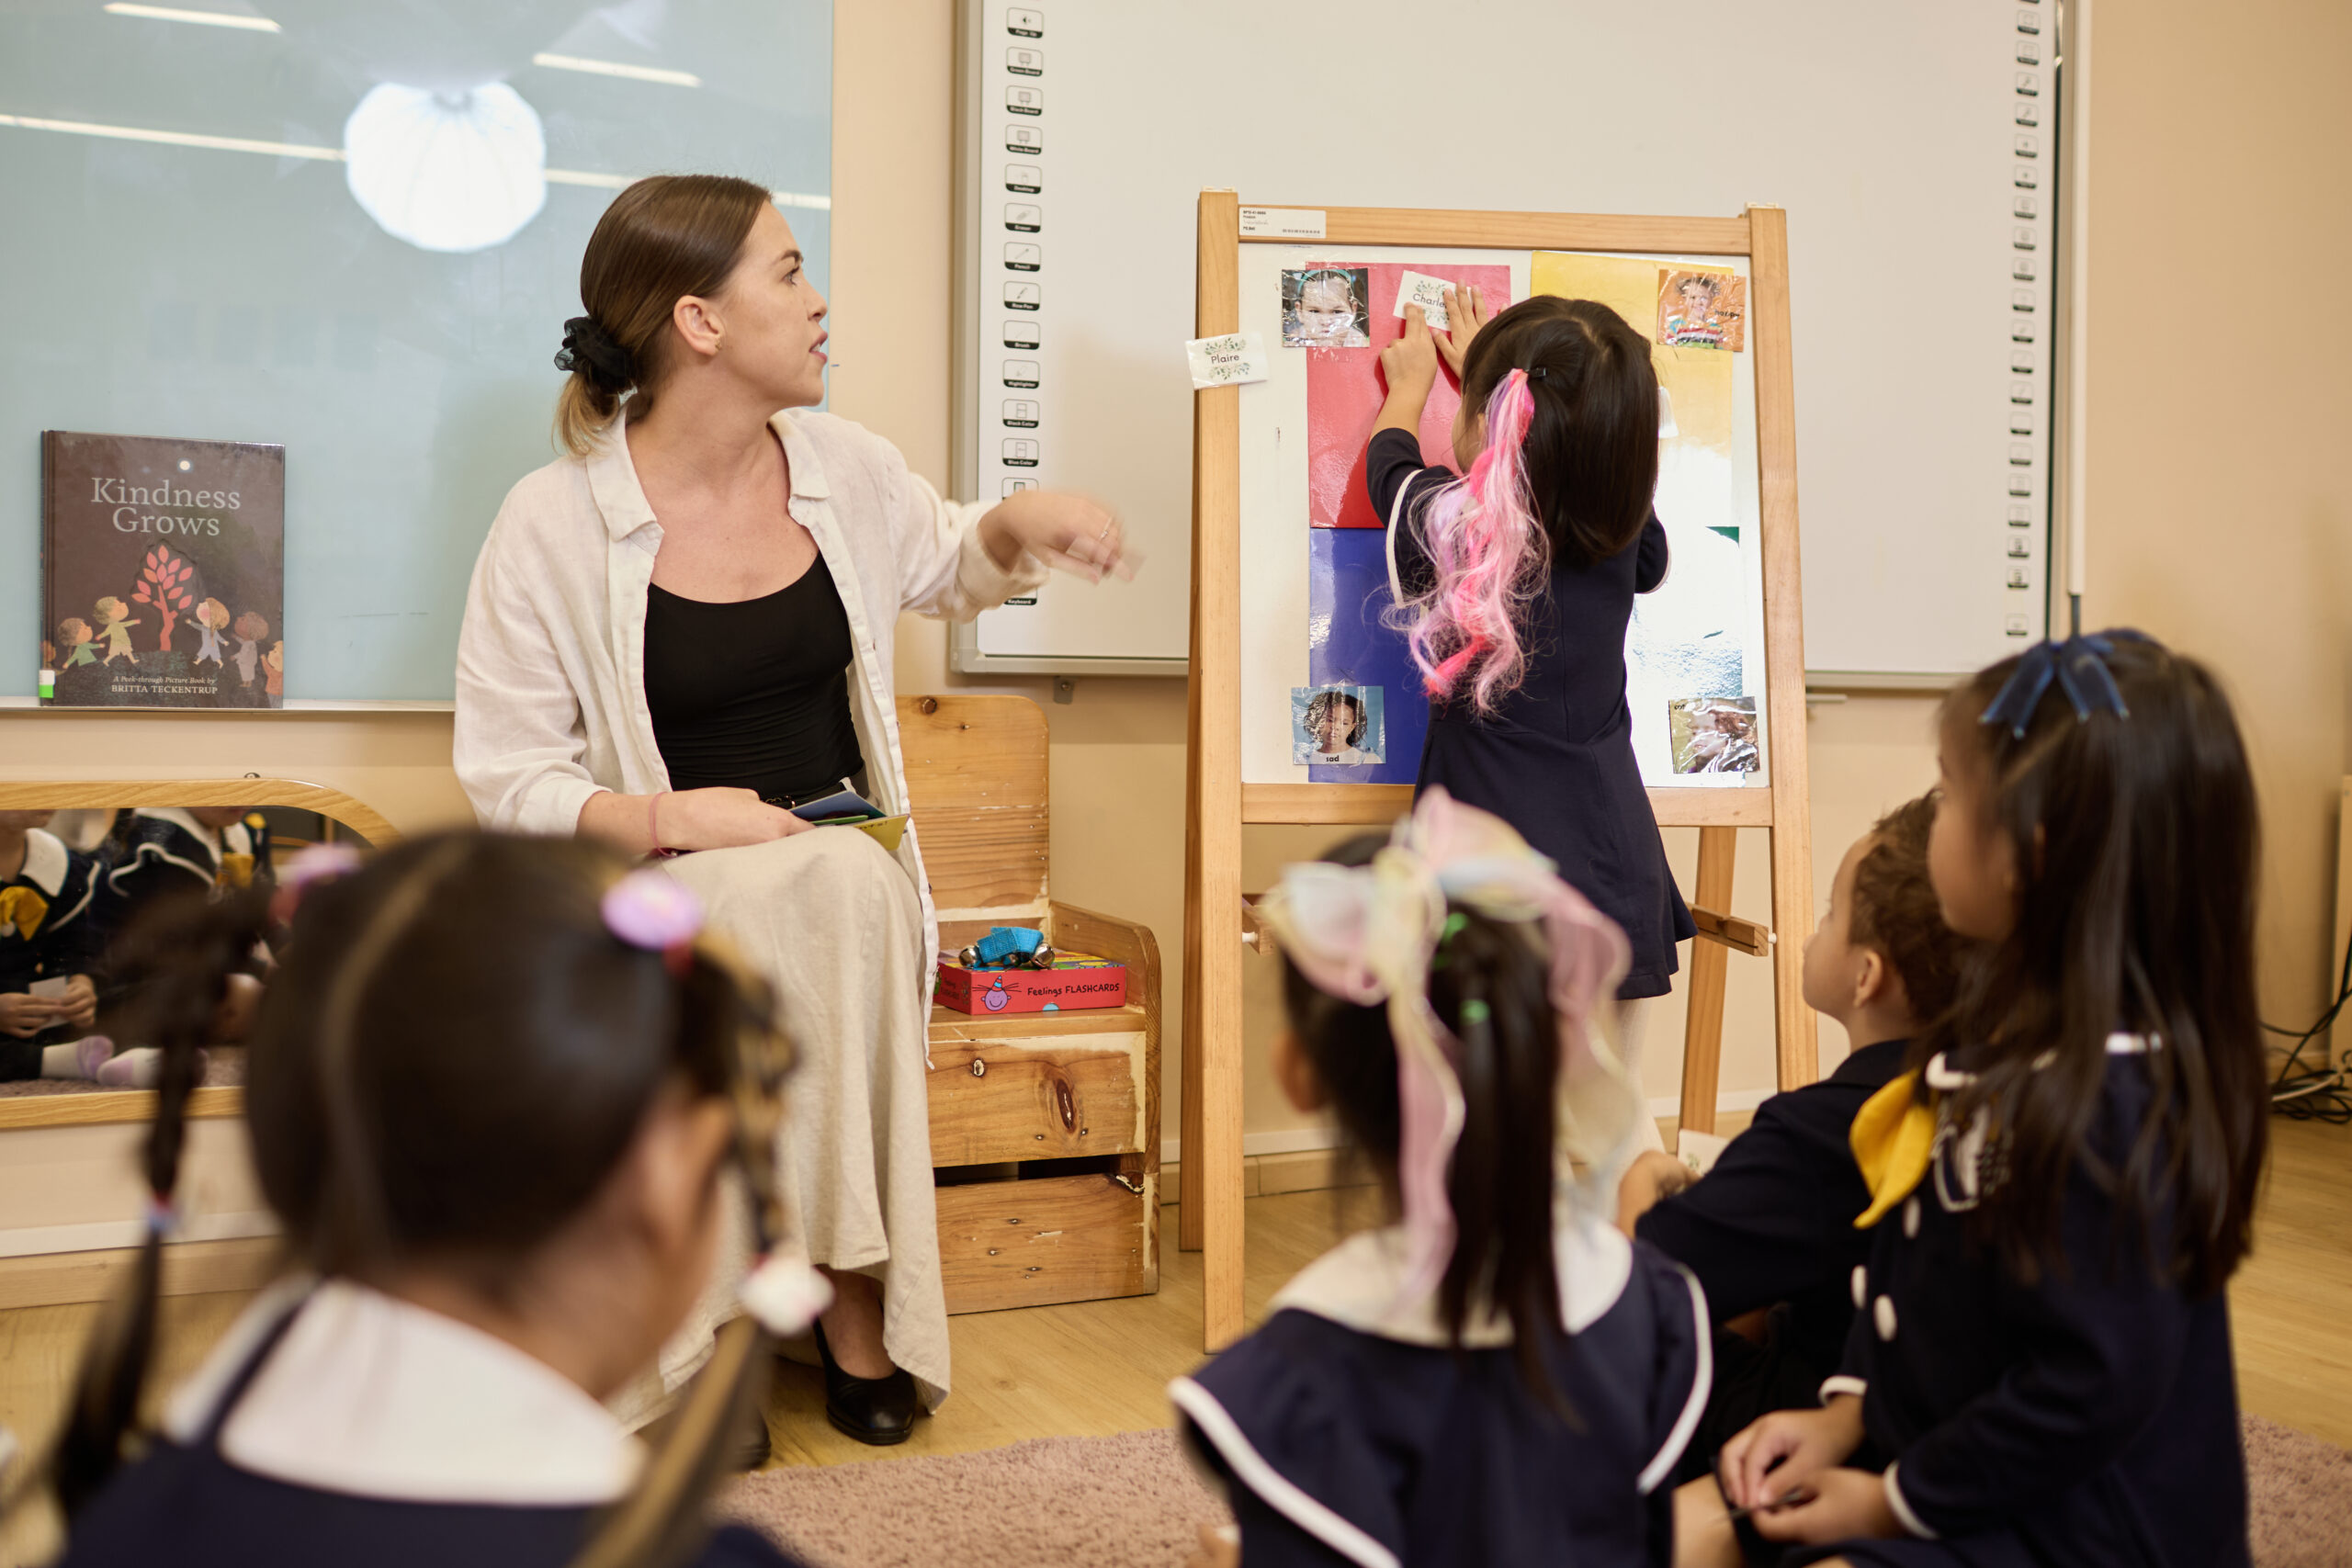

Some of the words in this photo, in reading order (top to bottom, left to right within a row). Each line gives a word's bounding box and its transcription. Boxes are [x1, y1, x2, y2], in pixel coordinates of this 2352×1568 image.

[1412, 293, 1445, 308] Charle
[1211, 354, 1239, 364] Plaire
[91, 477, 241, 510] Kindness
[112, 506, 220, 536] Grows
[111, 684, 148, 693] BRITTA
[151, 685, 218, 694] TECKENTRUP
[1027, 987, 1062, 997] Feelings
[1066, 983, 1119, 993] FLASHCARDS
